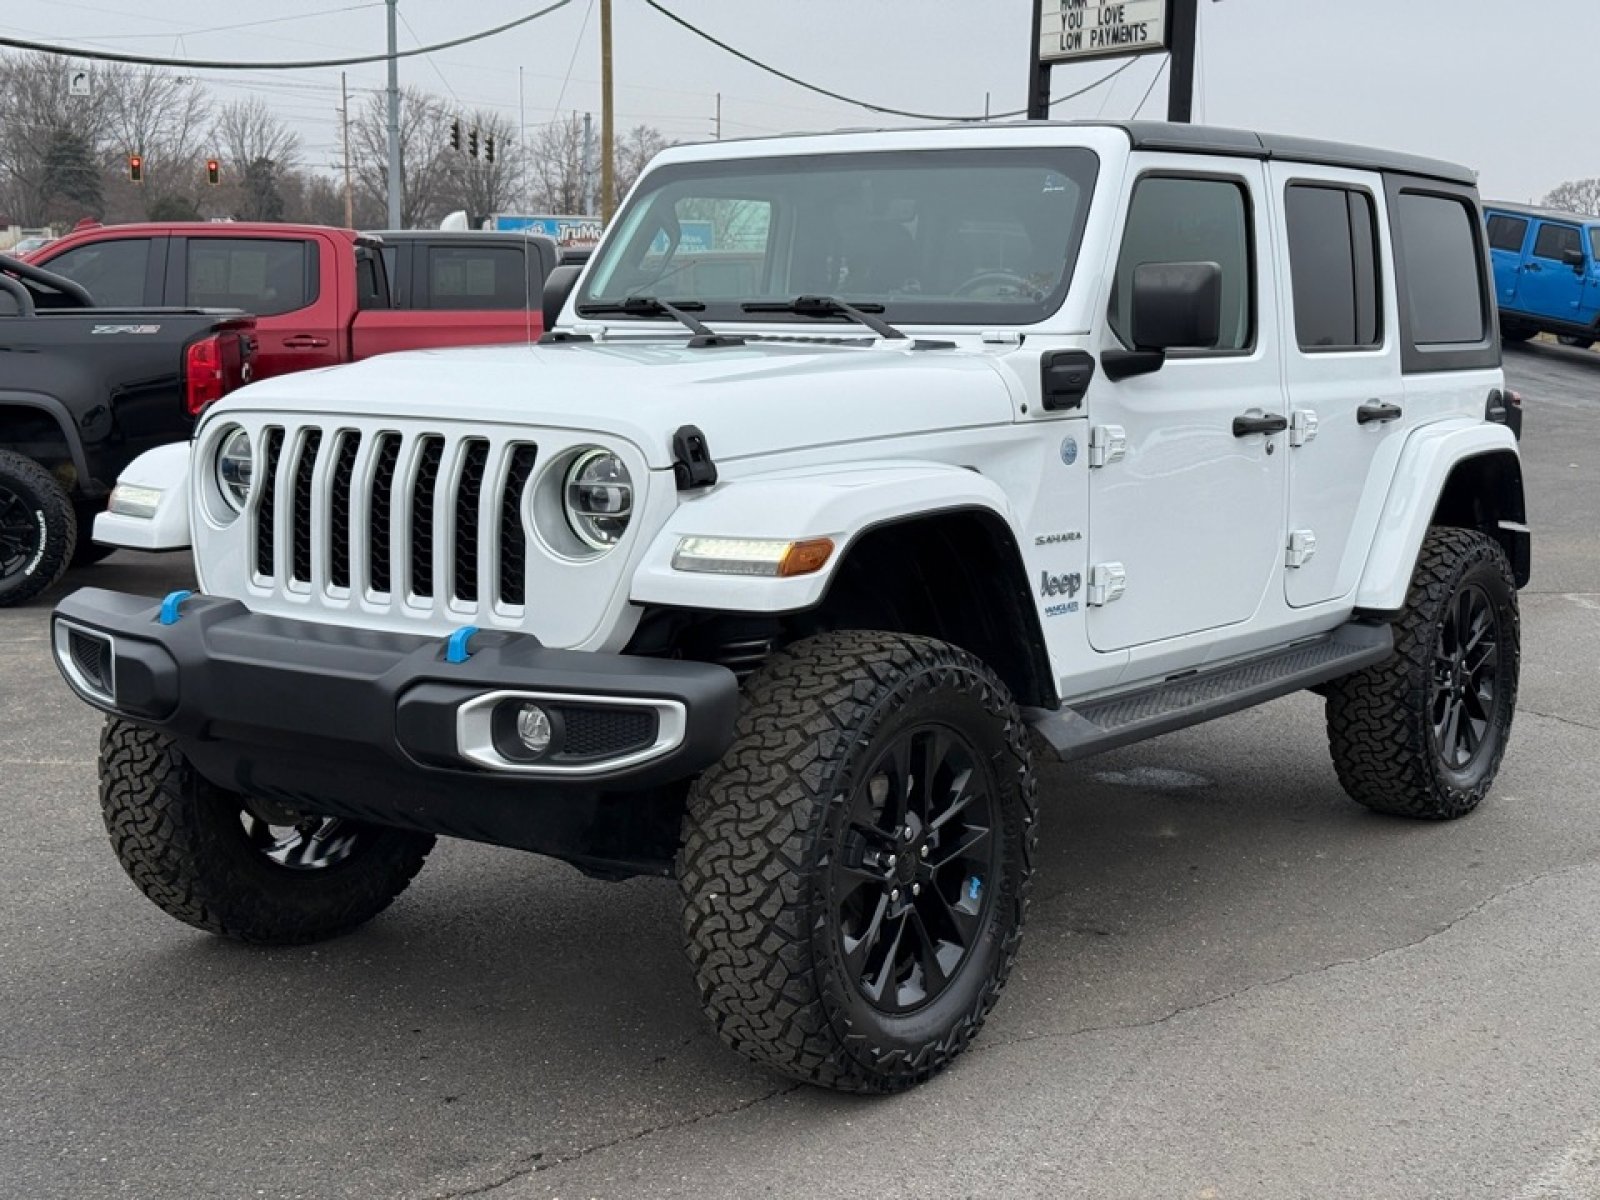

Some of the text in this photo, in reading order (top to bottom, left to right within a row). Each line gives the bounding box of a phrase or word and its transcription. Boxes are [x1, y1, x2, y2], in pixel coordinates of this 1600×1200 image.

[1061, 5, 1125, 31] YOU LOVE
[1060, 23, 1148, 50] LOW PAYMENTS
[1035, 532, 1082, 545] SAHARA
[1040, 570, 1081, 598] Jeep
